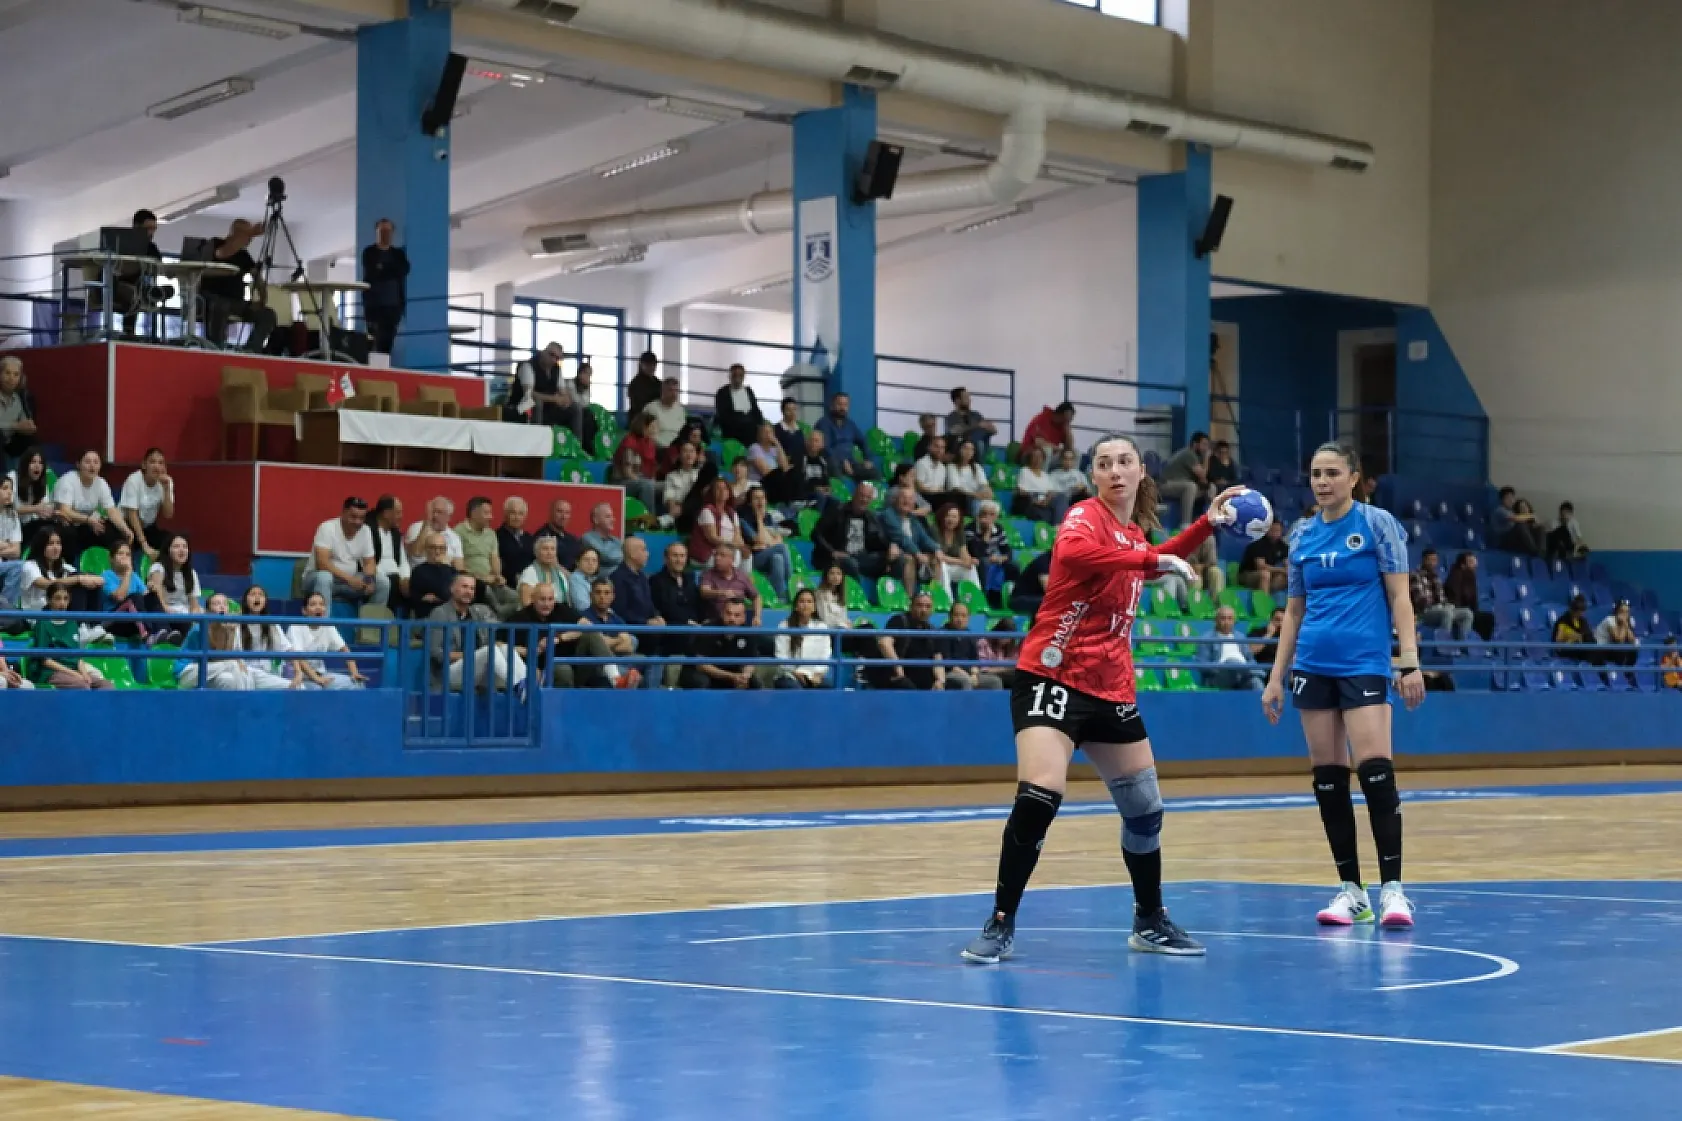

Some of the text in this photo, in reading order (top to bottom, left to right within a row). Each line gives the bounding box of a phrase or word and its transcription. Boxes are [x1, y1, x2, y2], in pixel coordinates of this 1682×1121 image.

[1320, 551, 1338, 569] 17
[1293, 676, 1308, 696] 17
[1027, 682, 1068, 720] 13
